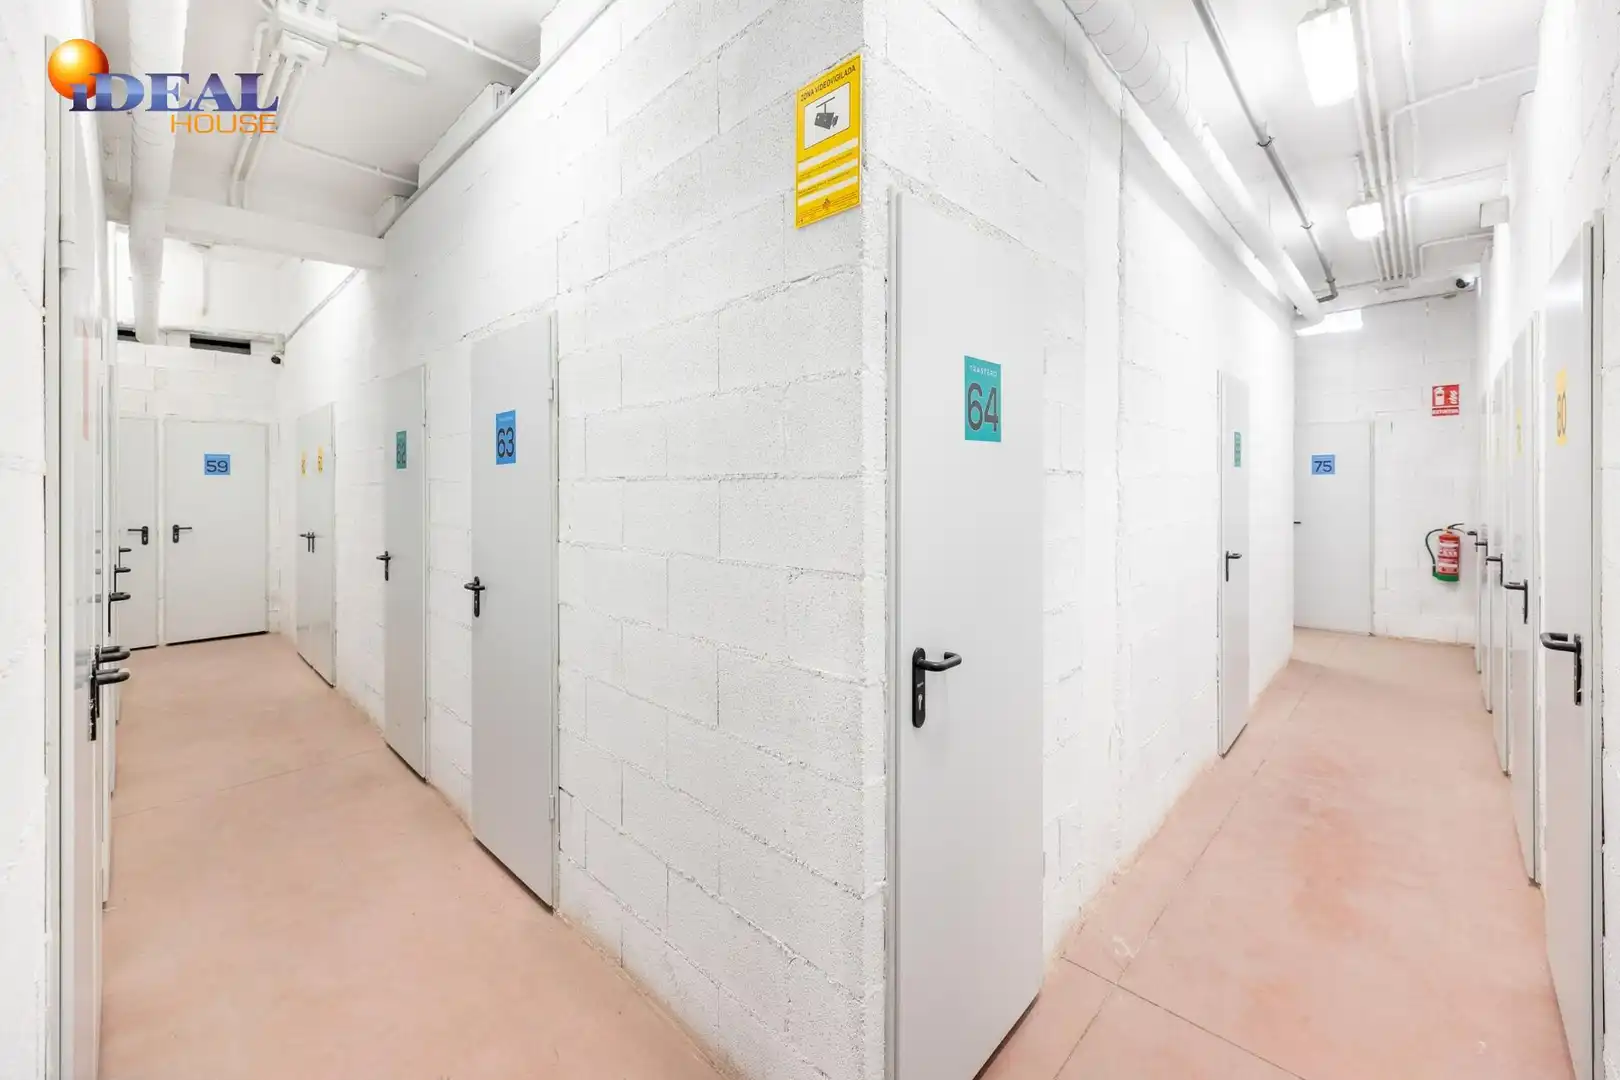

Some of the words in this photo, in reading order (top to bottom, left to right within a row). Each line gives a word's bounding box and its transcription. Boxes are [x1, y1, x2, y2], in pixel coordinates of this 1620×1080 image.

[815, 64, 856, 94] VIDEOVIGILADA
[967, 382, 999, 433] 64
[497, 426, 515, 458] 63
[206, 460, 228, 473] 59
[1313, 460, 1333, 473] 75
